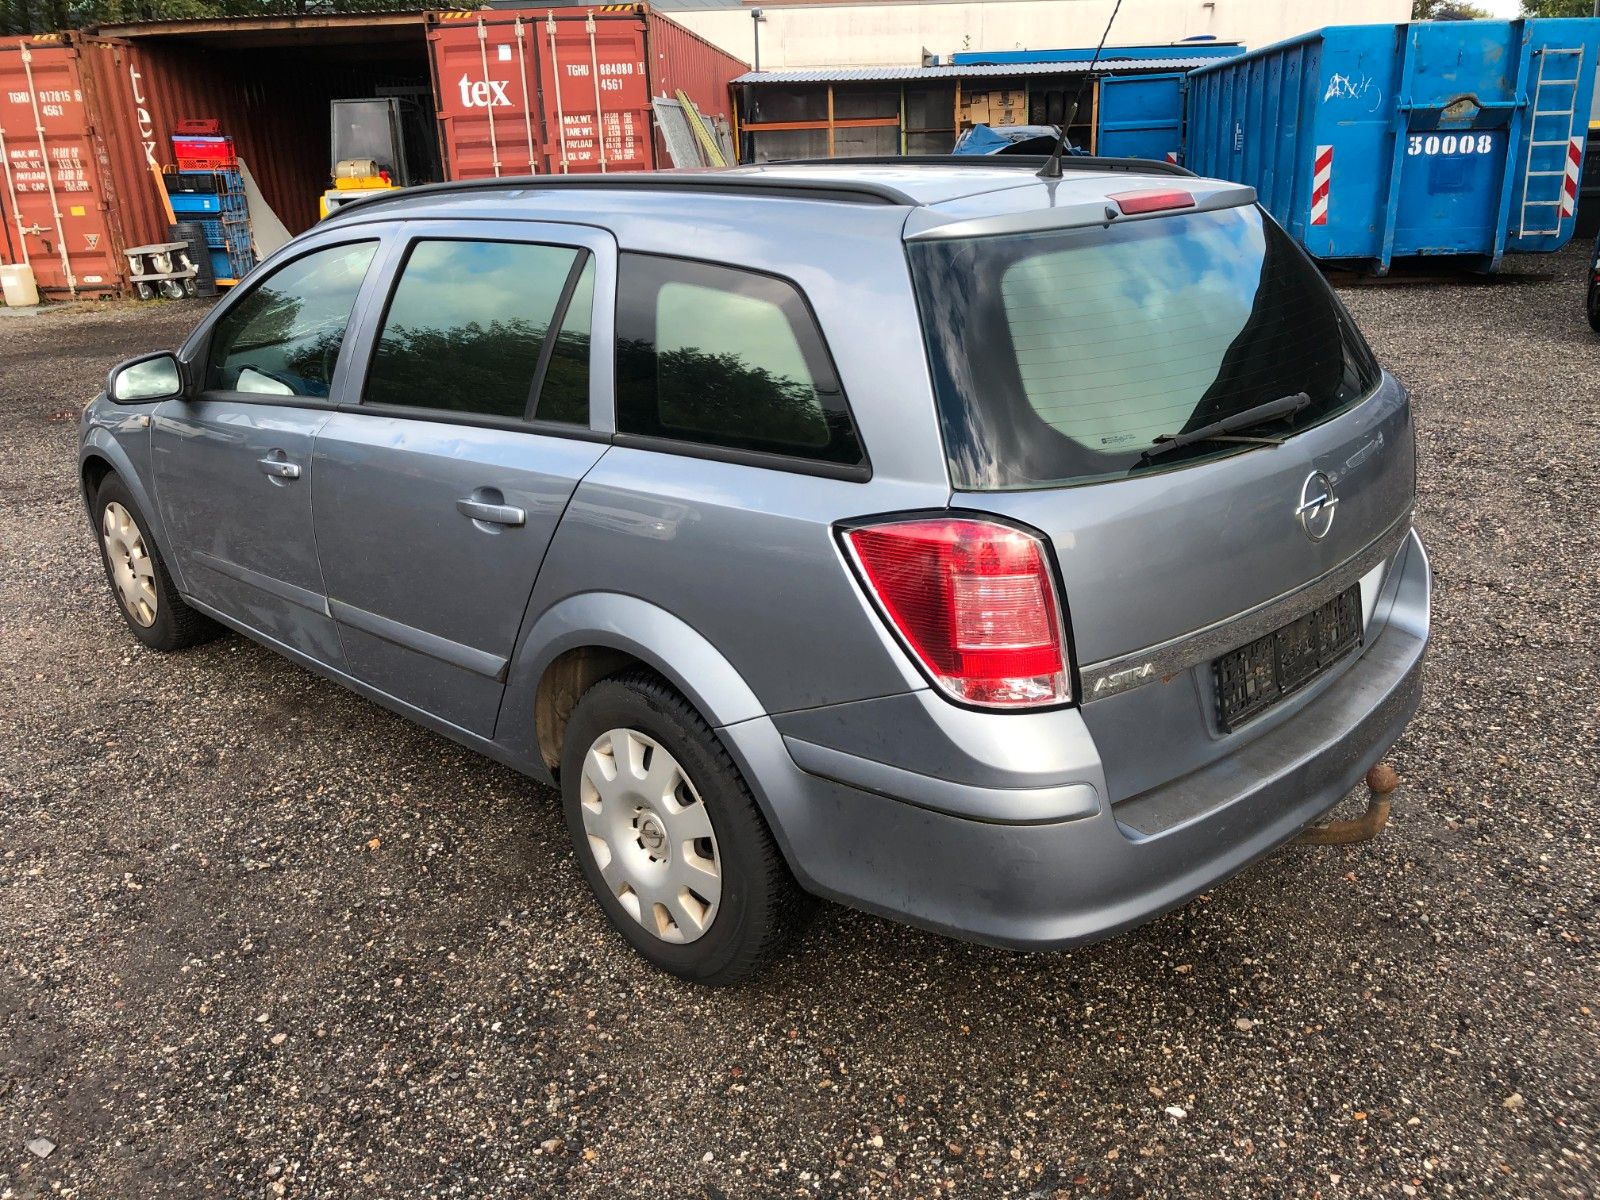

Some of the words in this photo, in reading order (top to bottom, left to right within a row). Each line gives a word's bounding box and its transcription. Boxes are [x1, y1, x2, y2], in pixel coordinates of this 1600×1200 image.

[566, 64, 589, 76] TGHU
[458, 73, 513, 108] tex
[130, 64, 161, 171] tex
[566, 140, 593, 148] PAYLOAD
[1407, 135, 1491, 156] 30008
[1094, 663, 1155, 692] ASTRA
